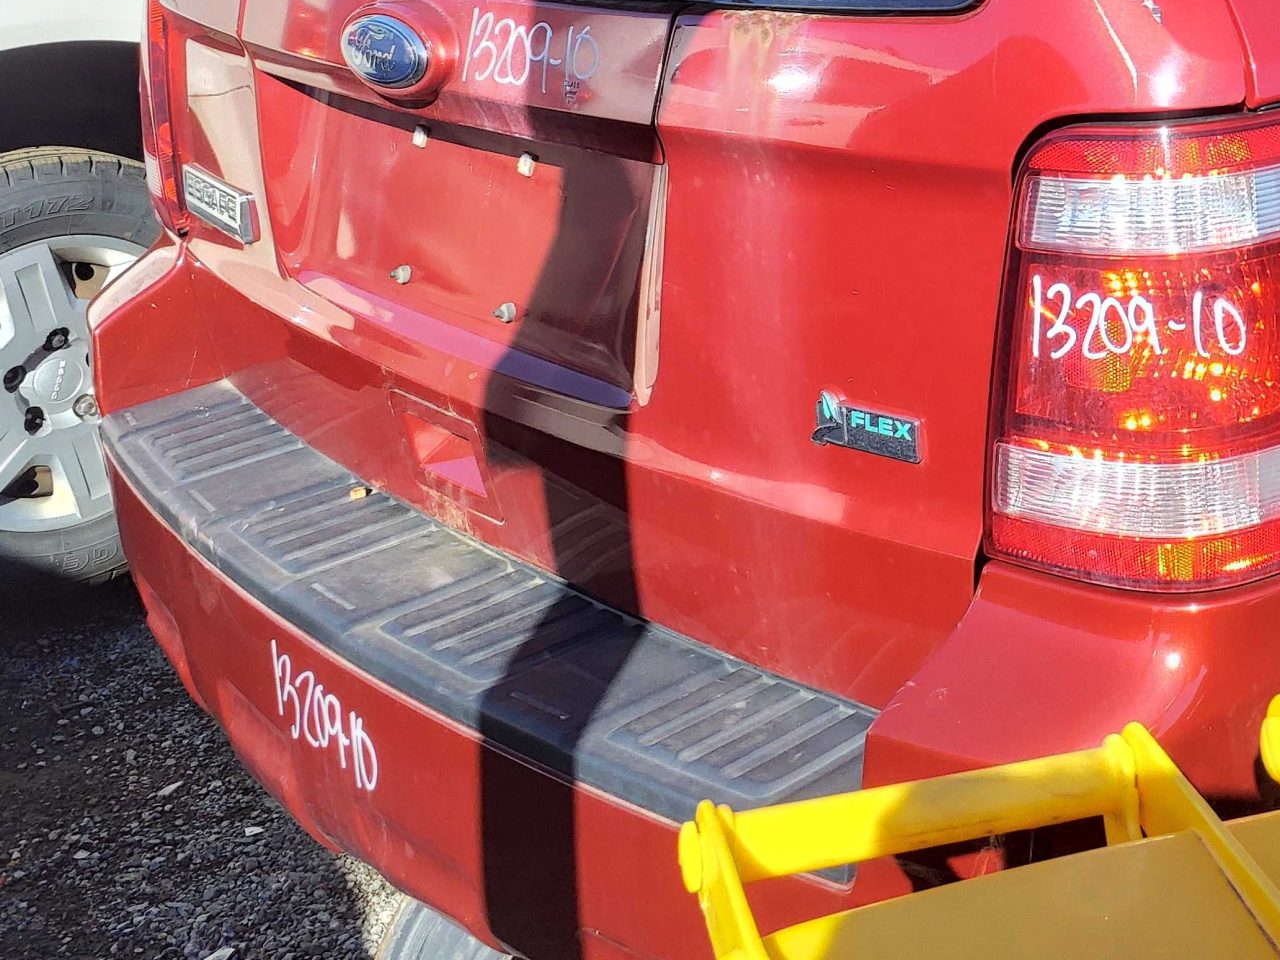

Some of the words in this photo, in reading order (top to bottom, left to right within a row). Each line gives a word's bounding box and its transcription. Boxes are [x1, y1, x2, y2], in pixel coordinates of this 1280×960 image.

[351, 24, 396, 71] Ford
[461, 6, 600, 94] 13209-10
[1032, 273, 1248, 360] 13209-10
[850, 410, 913, 441] FLEX
[271, 638, 379, 792] 13209-10
